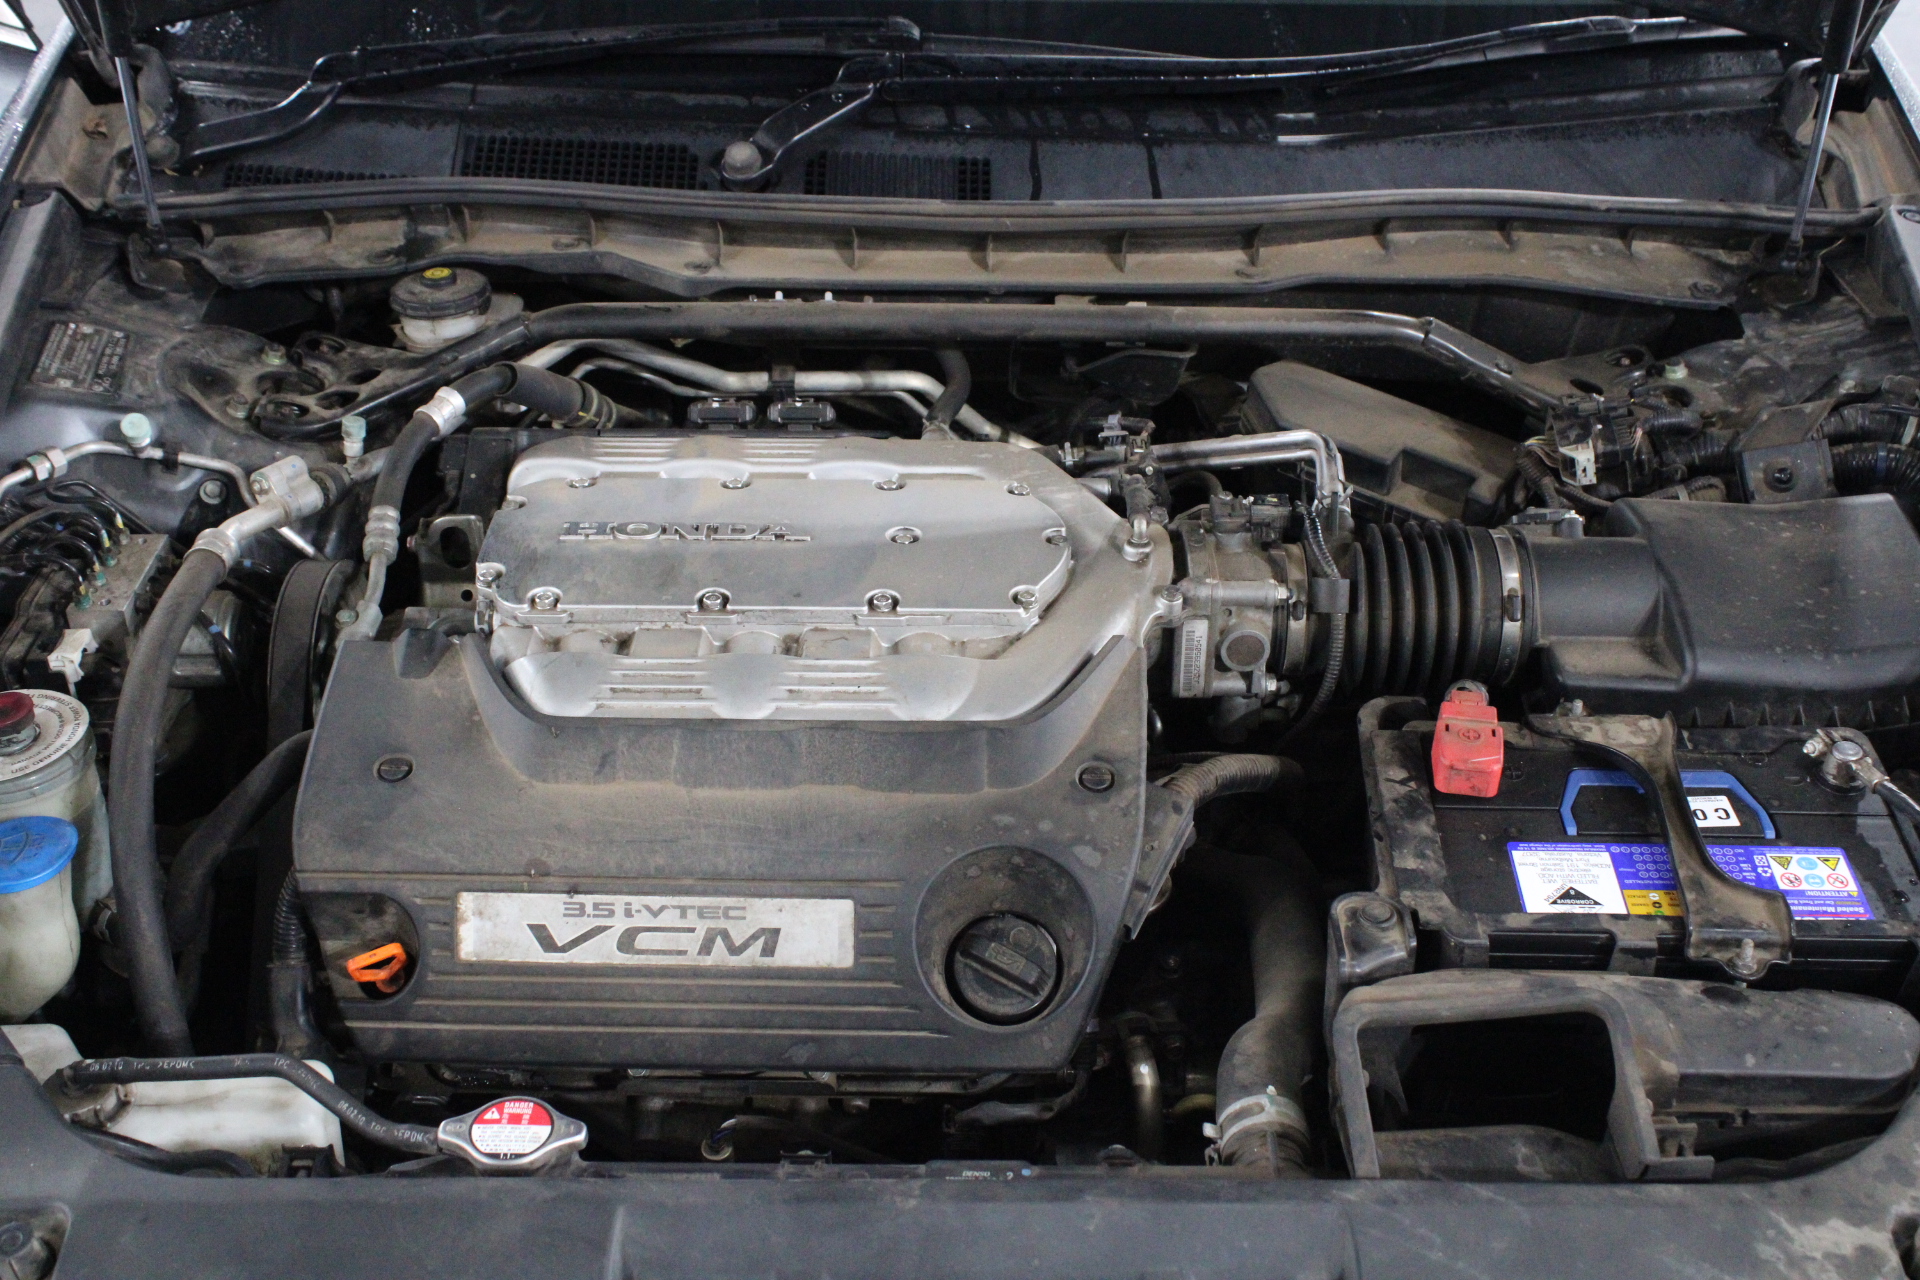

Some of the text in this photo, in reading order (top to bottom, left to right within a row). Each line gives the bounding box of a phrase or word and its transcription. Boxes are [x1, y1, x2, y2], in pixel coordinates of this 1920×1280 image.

[559, 521, 811, 541] HONDA
[36, 693, 73, 707] STEERING
[69, 703, 82, 721] POWER
[67, 721, 81, 742] HONDA
[32, 742, 67, 766] GENUINE
[562, 901, 747, 921] 3.5 i-VTEC
[525, 923, 782, 958] VCM
